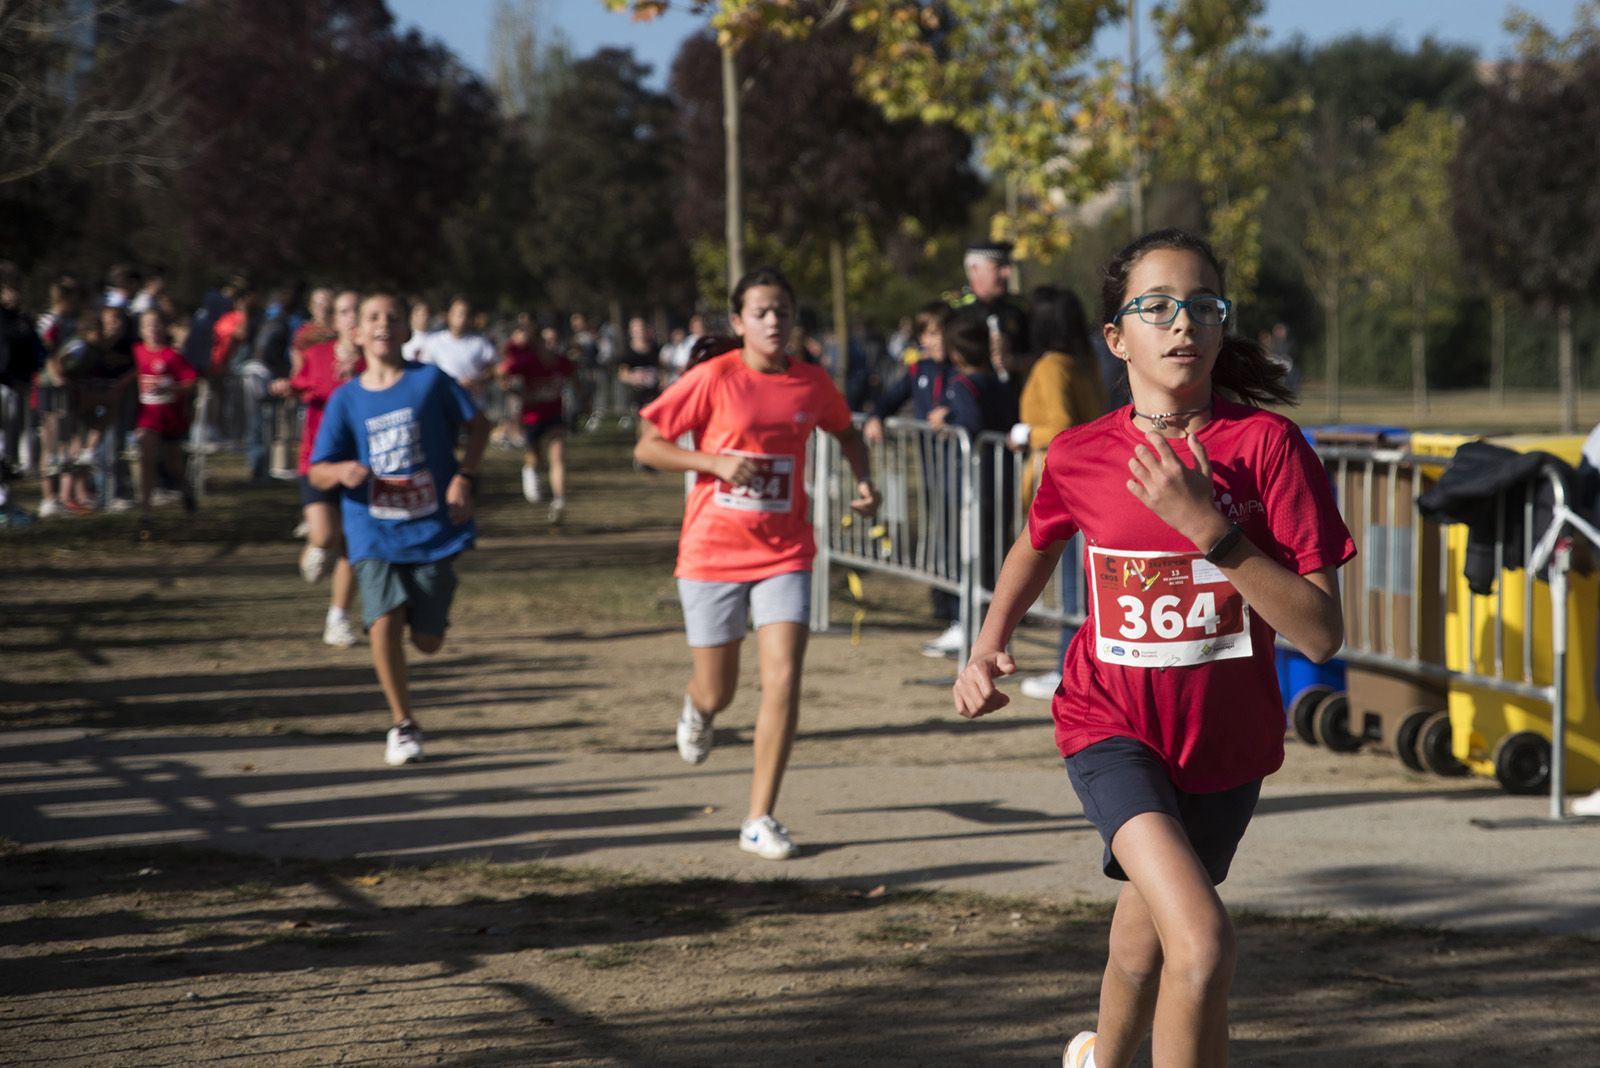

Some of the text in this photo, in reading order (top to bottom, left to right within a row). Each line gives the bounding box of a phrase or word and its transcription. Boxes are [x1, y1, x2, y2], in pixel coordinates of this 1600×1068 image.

[1228, 500, 1266, 517] AMPA
[1100, 573, 1118, 582] CROS
[1171, 569, 1180, 577] 13
[1117, 592, 1221, 639] 364
